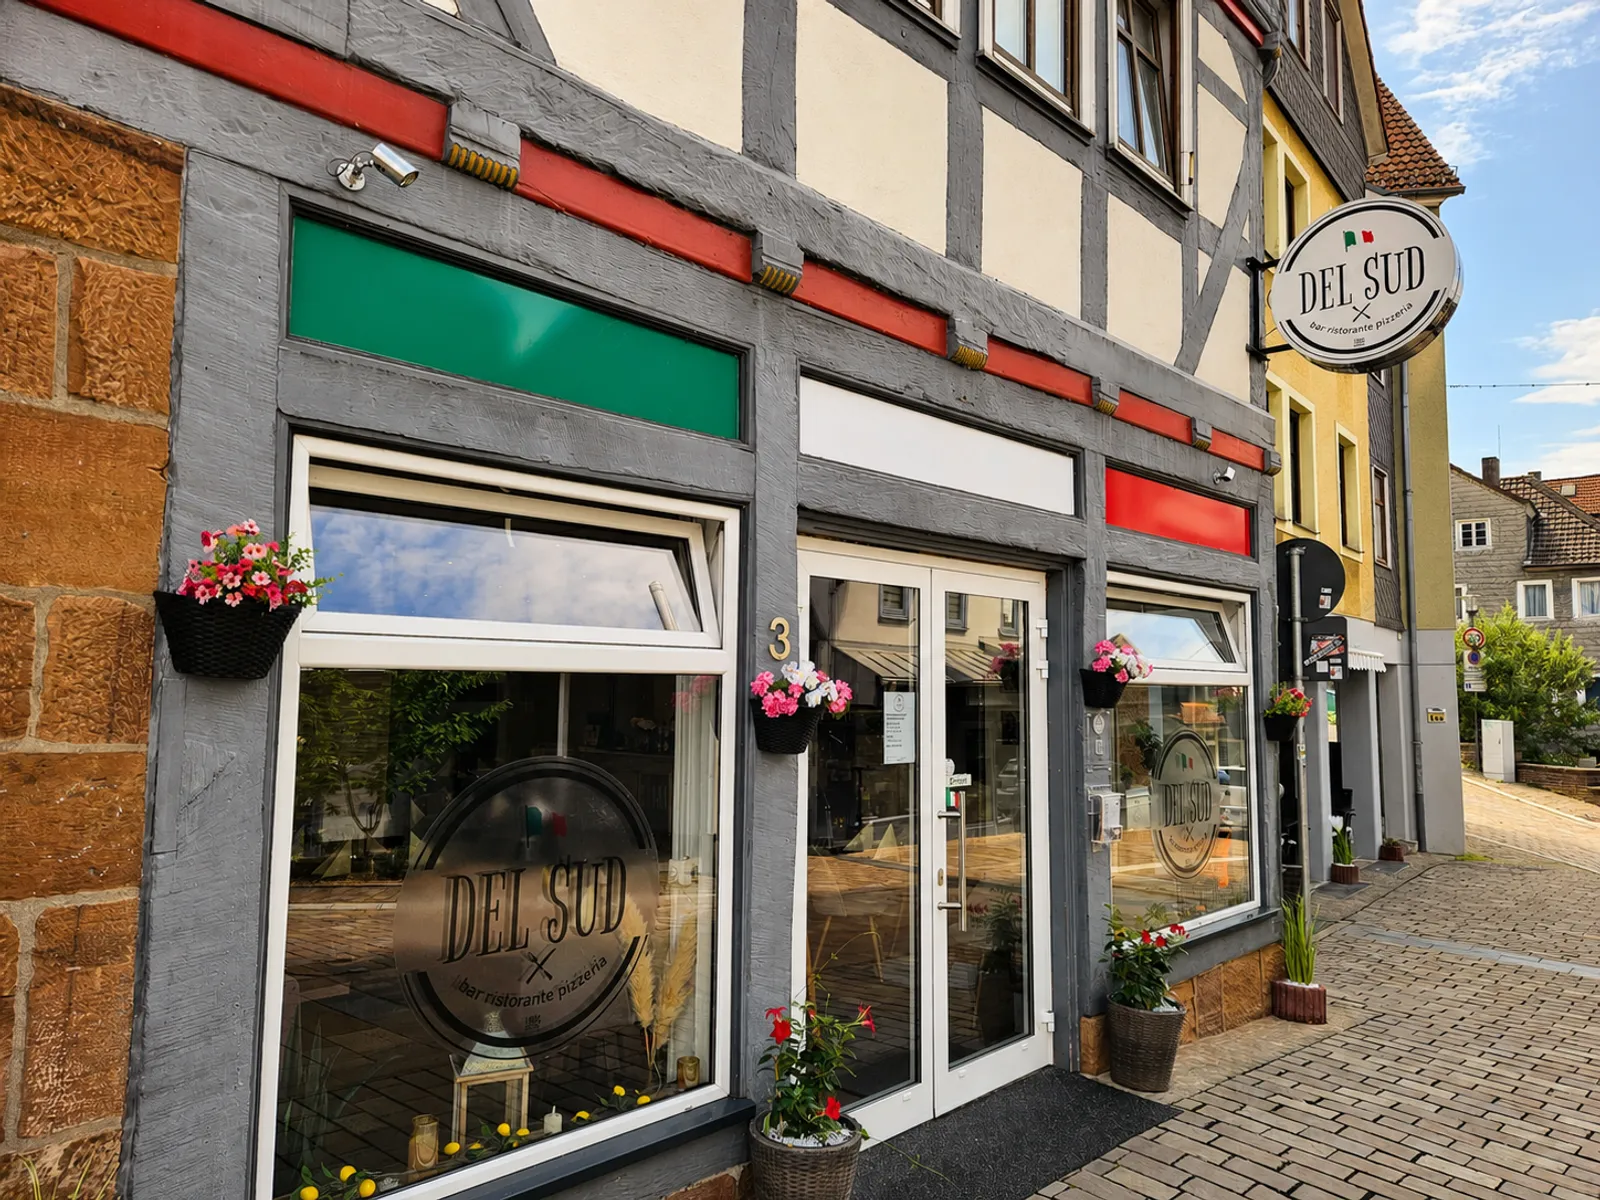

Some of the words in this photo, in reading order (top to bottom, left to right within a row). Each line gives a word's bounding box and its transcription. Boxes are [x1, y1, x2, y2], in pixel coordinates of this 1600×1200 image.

[1299, 263, 1353, 315] DEL
[1364, 246, 1425, 300] SUD
[1309, 320, 1326, 332] bar
[1326, 324, 1374, 335] ristorante
[1375, 302, 1413, 330] pizzeria
[769, 616, 790, 660] 3
[1163, 783, 1186, 827] DEL
[1190, 781, 1212, 824] SUD
[442, 867, 529, 965] DEL
[547, 855, 627, 944] SUD
[459, 977, 483, 1001] bar
[483, 989, 555, 1008] ristorante
[557, 955, 608, 1001] pizzeria
